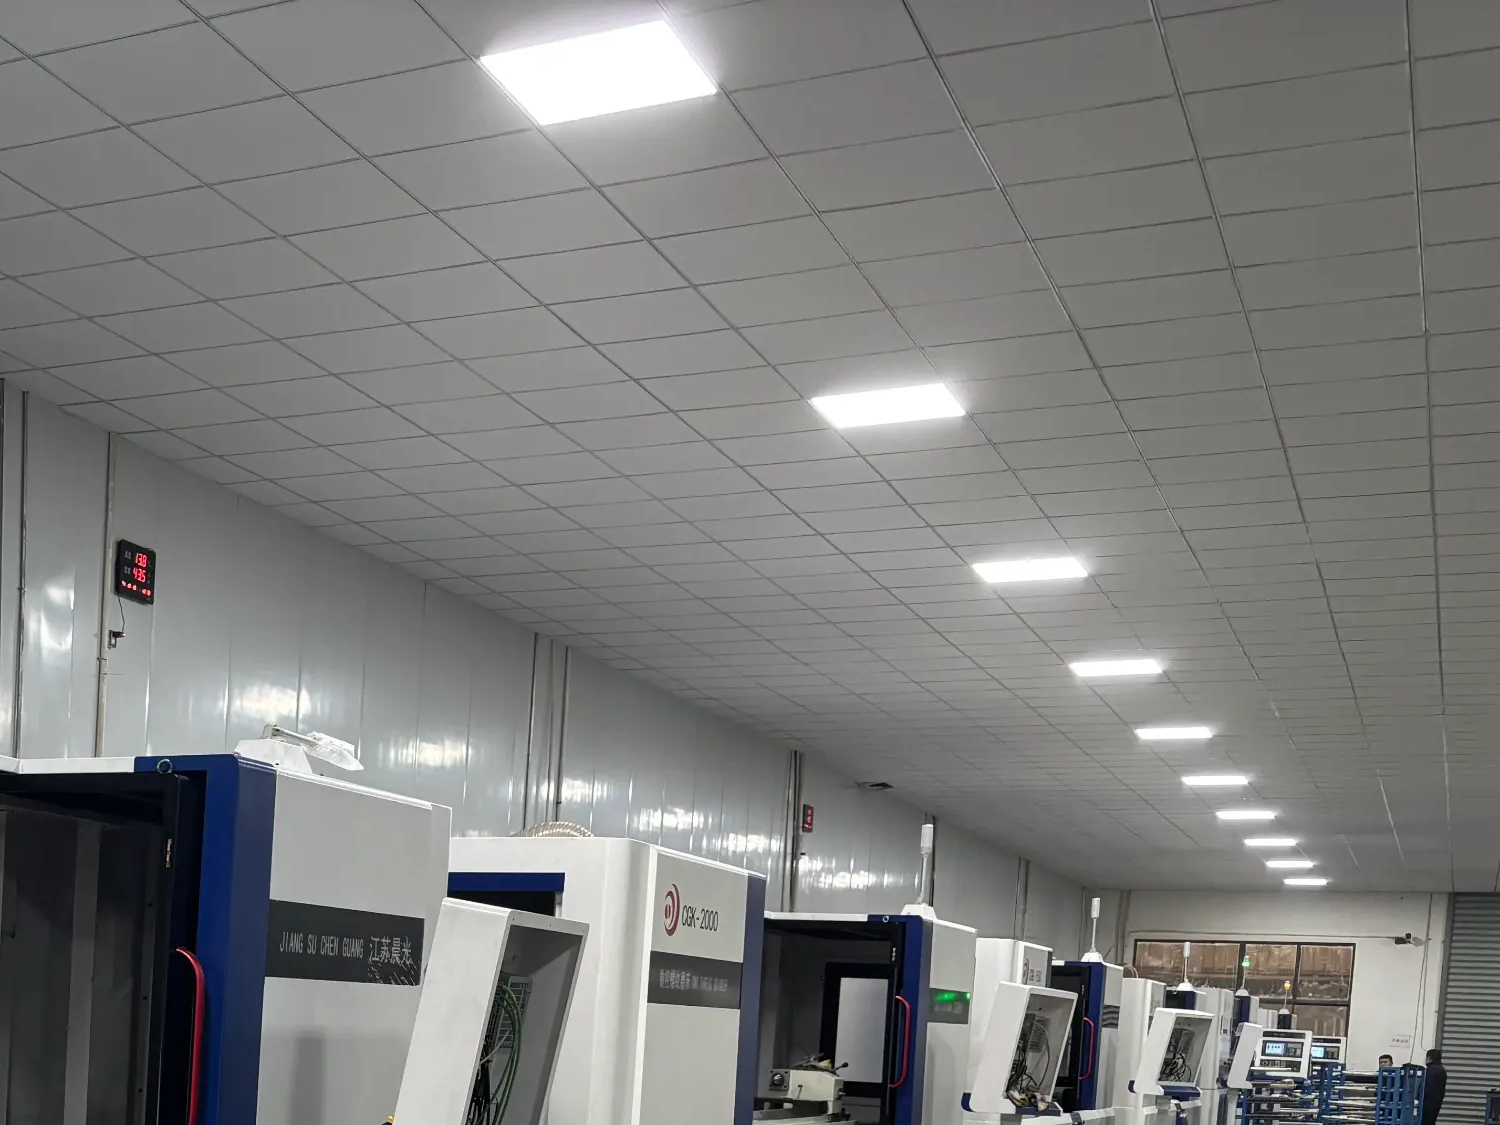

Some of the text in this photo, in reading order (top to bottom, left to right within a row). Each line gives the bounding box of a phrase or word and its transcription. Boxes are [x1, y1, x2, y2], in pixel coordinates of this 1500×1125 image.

[681, 904, 719, 932] CGK-2000
[279, 931, 364, 959] JIANG SU CHEN GUANG
